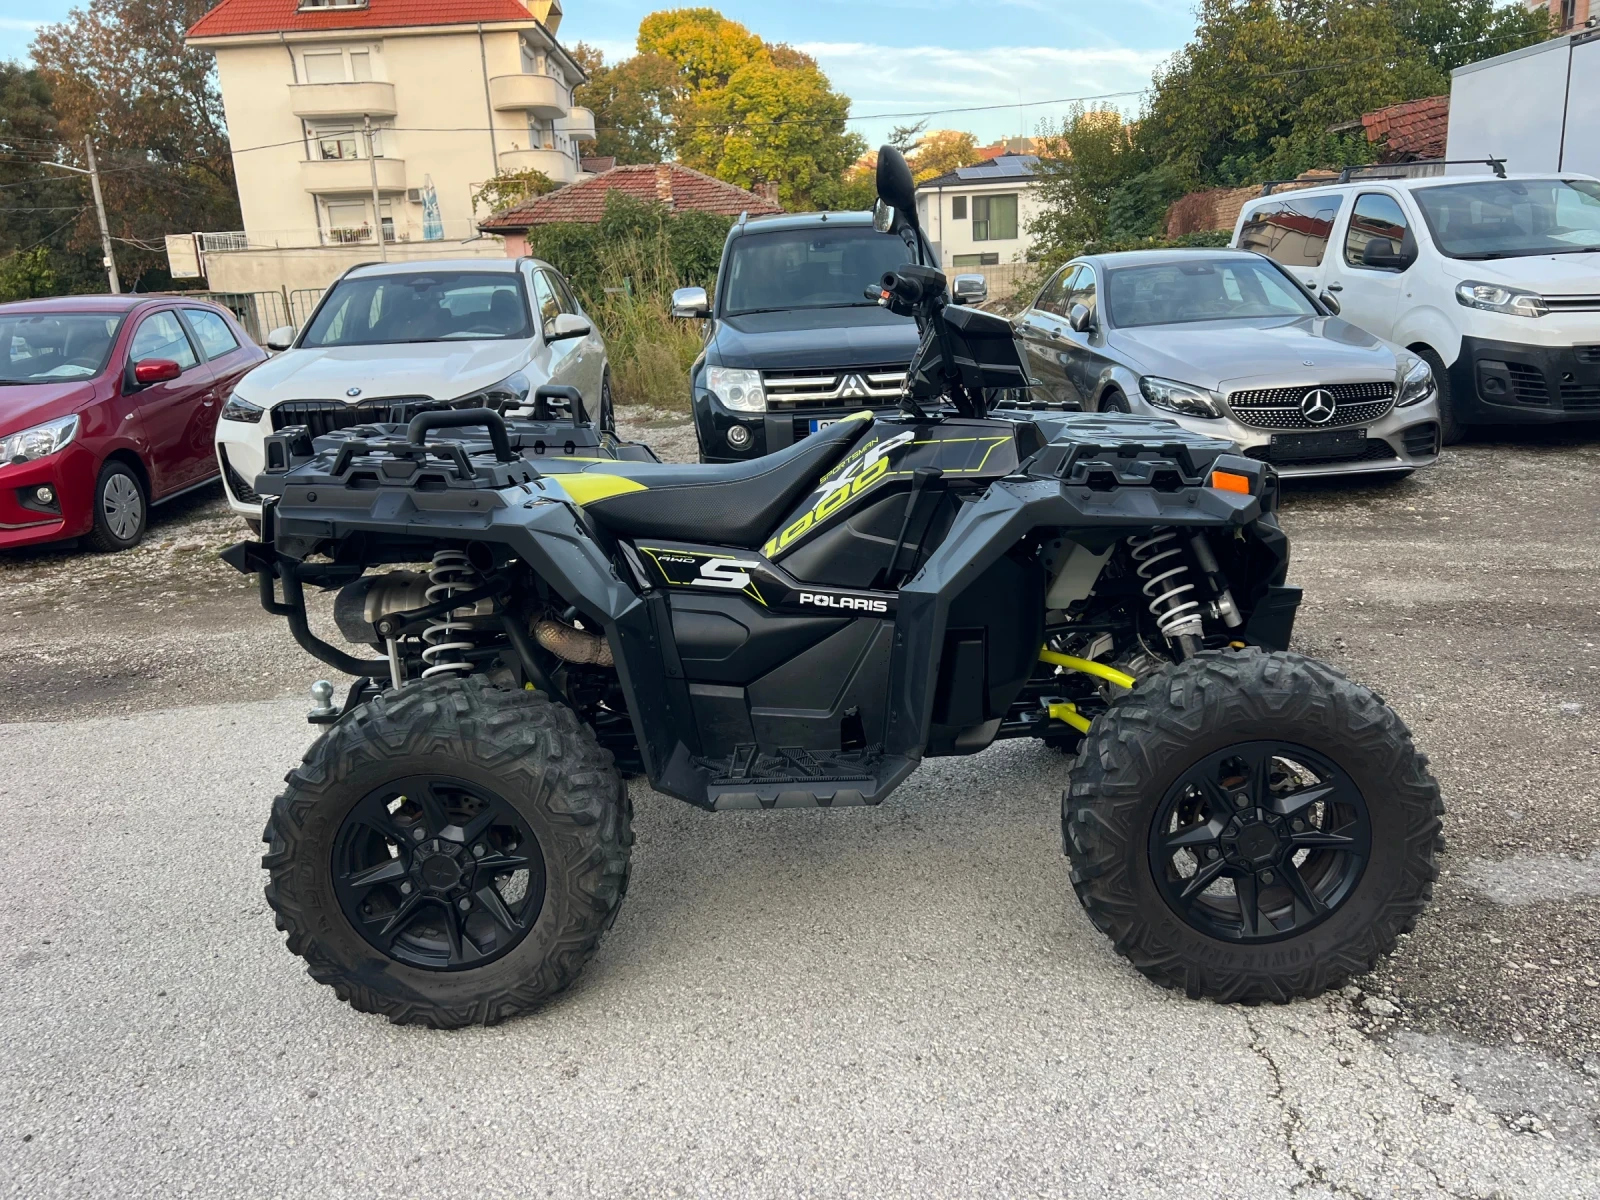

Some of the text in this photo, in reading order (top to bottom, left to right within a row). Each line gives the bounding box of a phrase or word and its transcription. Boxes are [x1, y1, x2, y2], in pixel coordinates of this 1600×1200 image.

[812, 430, 915, 511] XP
[819, 436, 879, 485] SPORTSMAN
[657, 556, 696, 564] AWD
[690, 557, 761, 589] S
[799, 592, 888, 613] POLARIS
